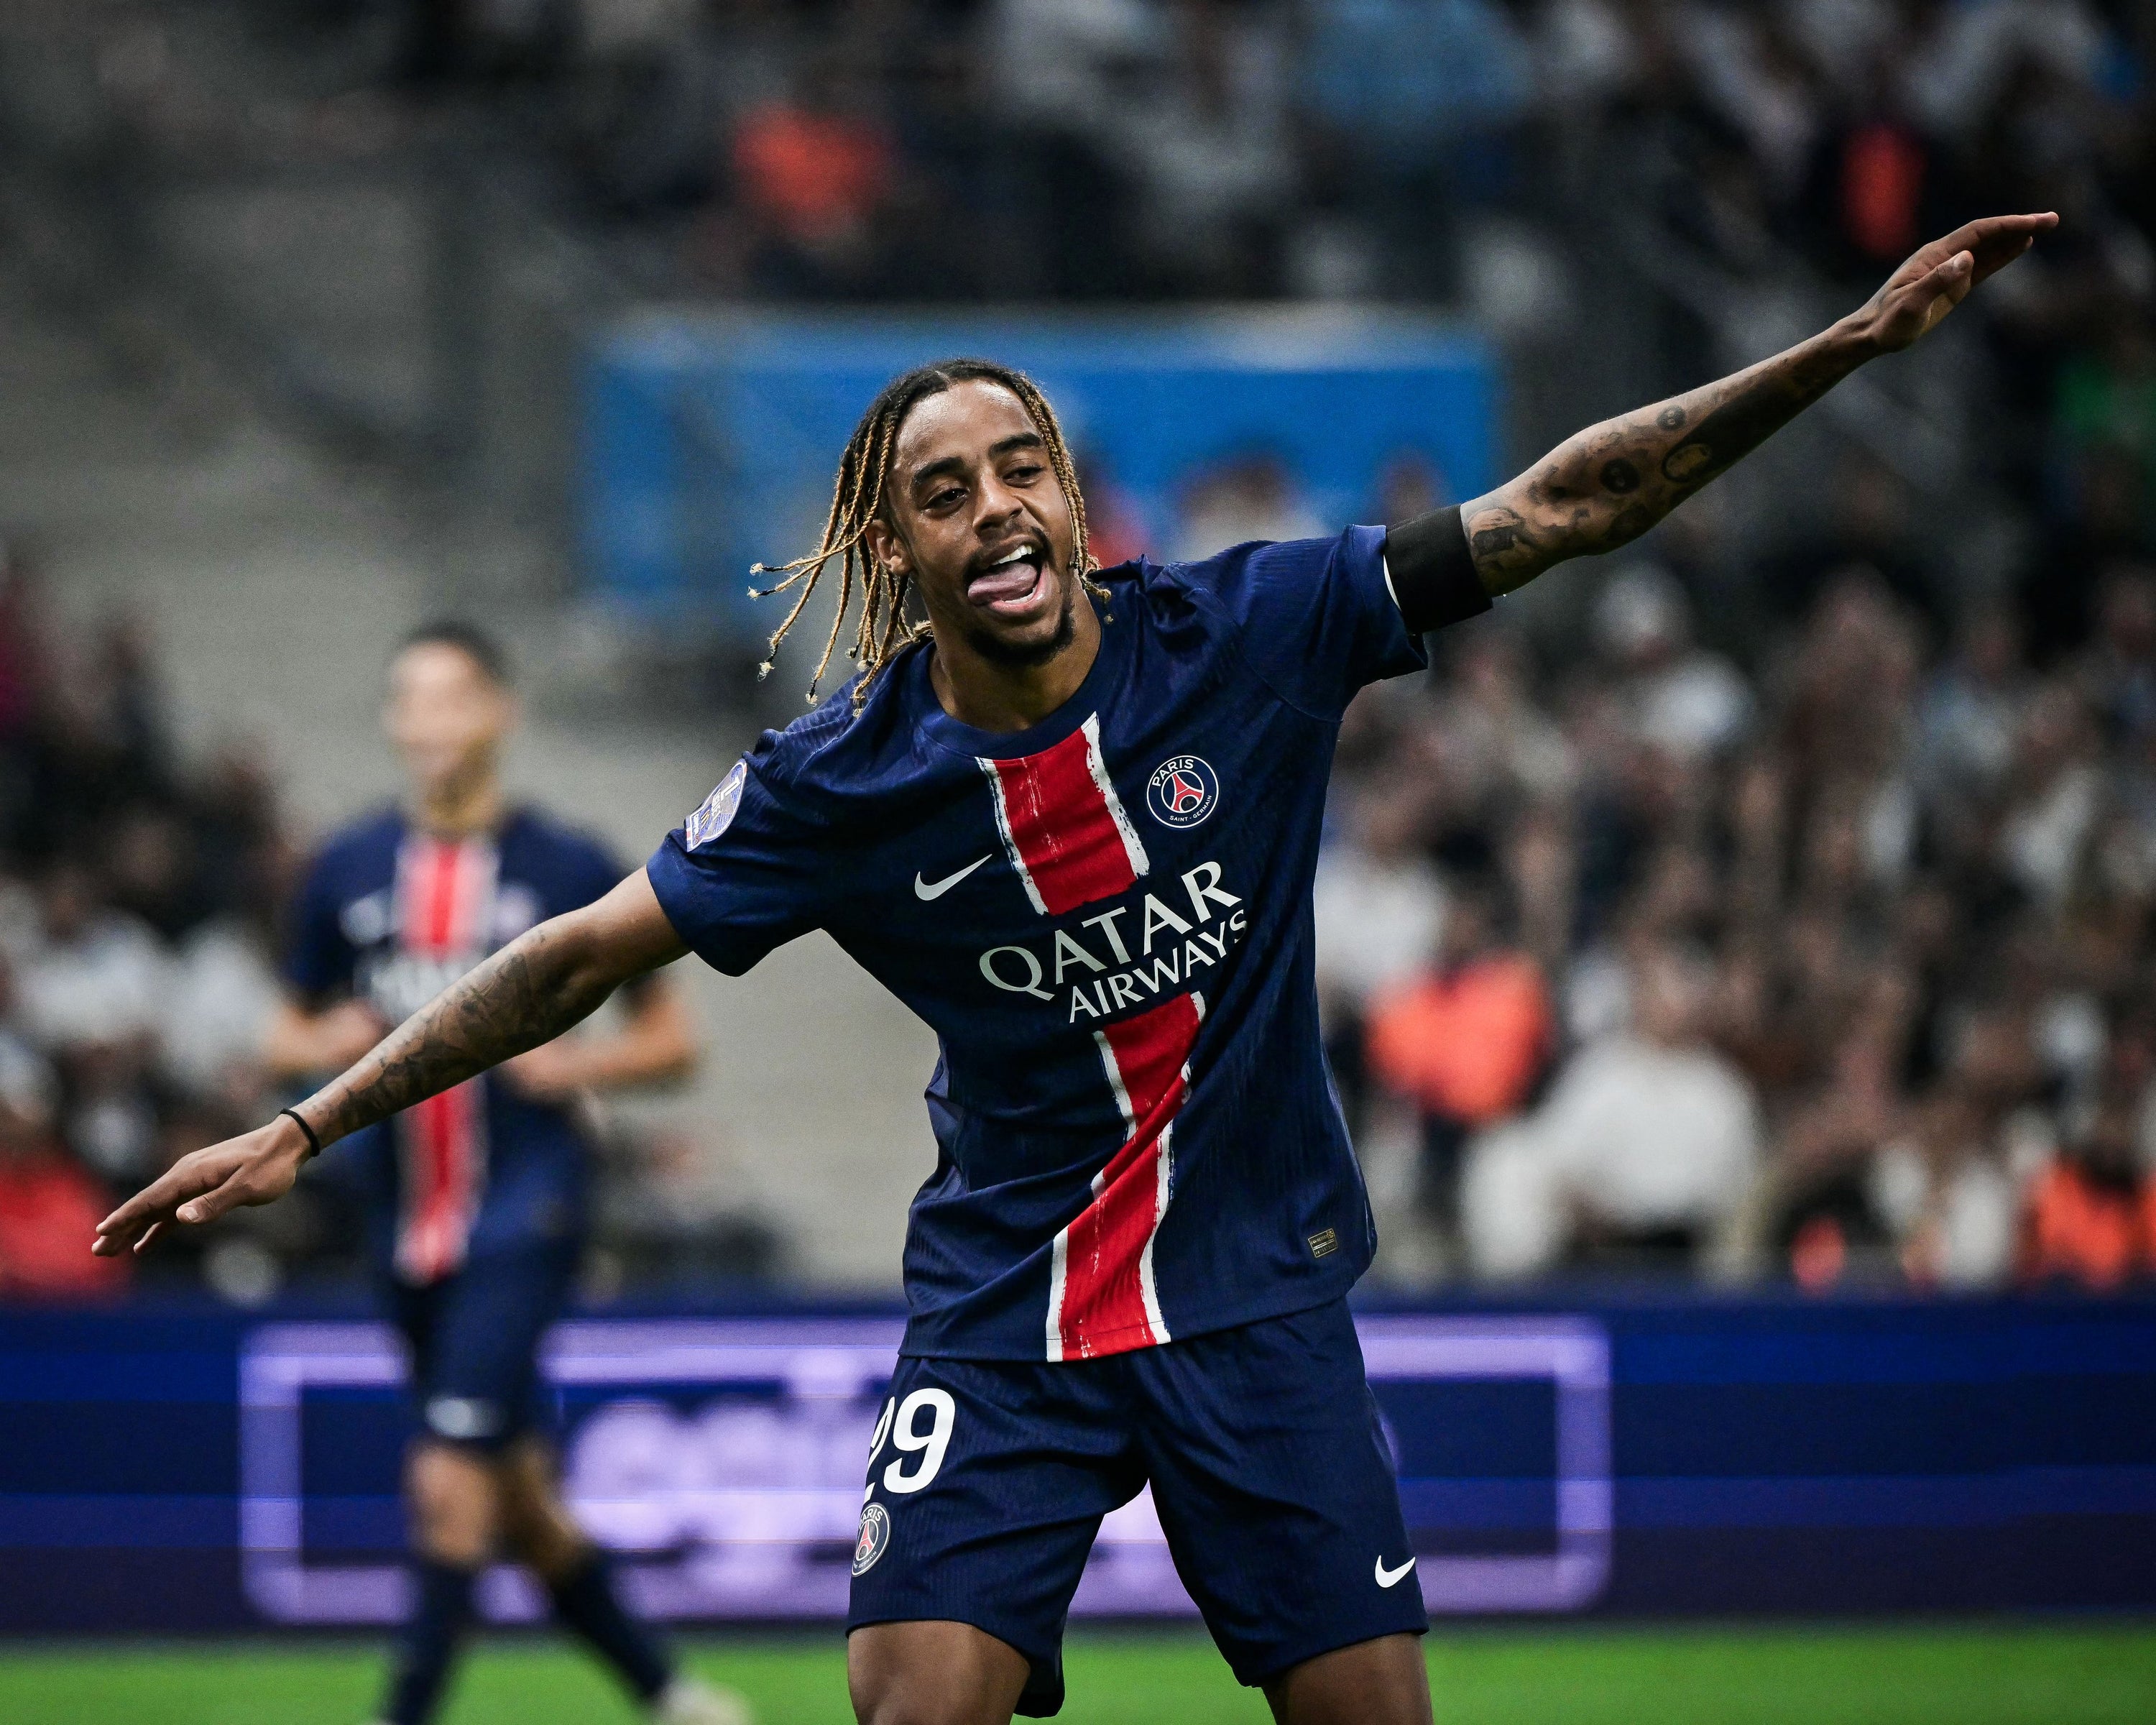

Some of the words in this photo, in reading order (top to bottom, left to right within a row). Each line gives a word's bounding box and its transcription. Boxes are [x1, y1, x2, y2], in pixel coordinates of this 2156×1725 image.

[1152, 759, 1194, 786] PARIS
[980, 861, 1242, 1000] QATAR
[1069, 909, 1248, 1023] AIRWAYS
